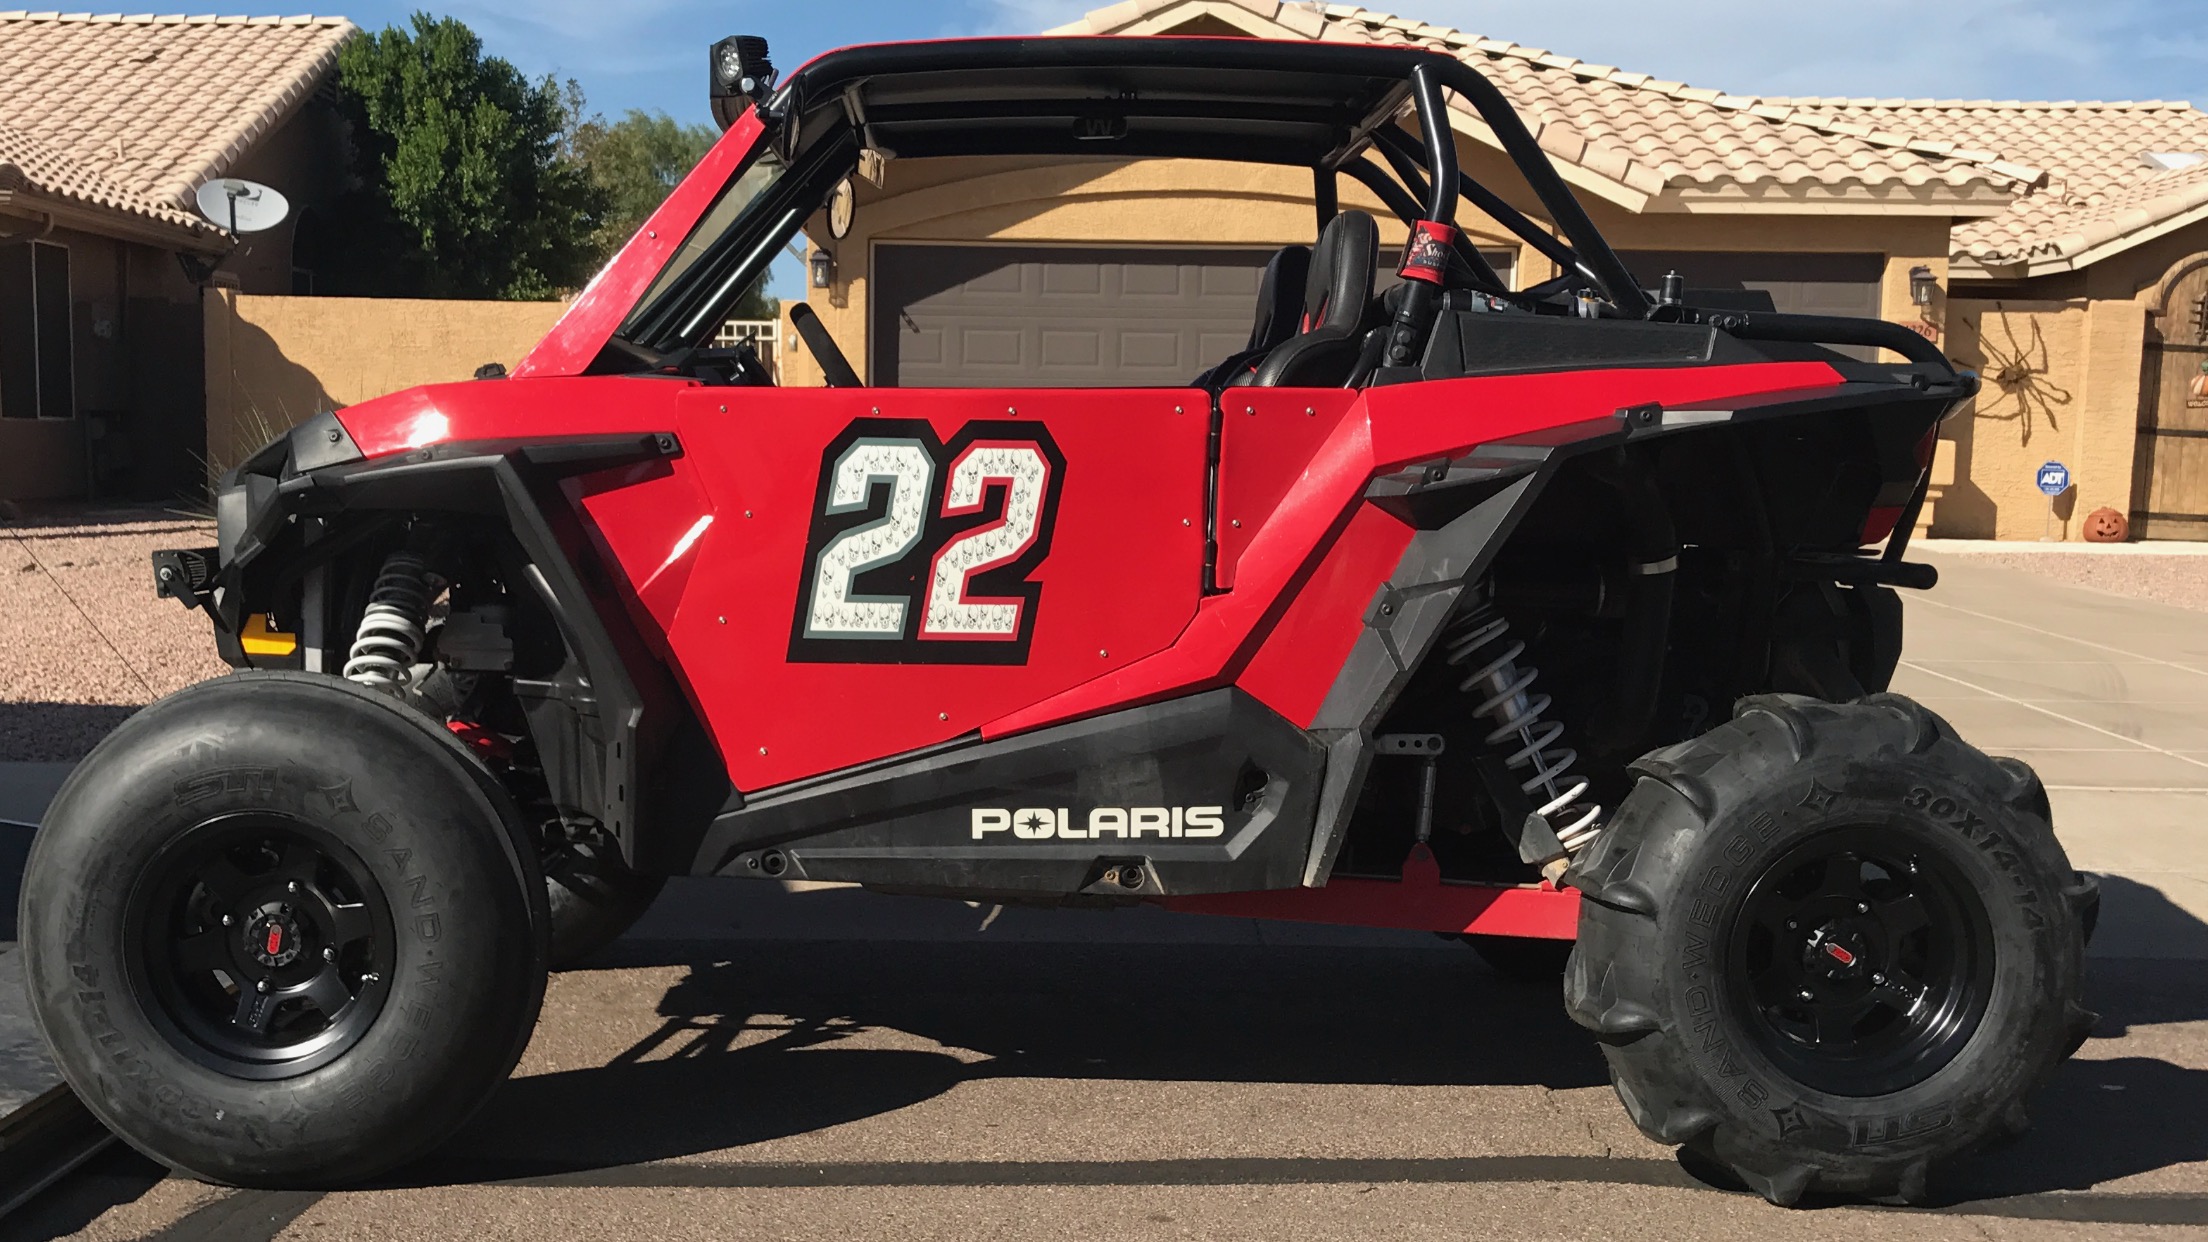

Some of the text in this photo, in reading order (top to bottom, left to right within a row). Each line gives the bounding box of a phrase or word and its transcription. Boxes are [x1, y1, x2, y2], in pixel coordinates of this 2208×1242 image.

[2041, 472, 2065, 485] ADT
[804, 437, 1051, 641] 22
[971, 805, 1225, 840] POLARIS
